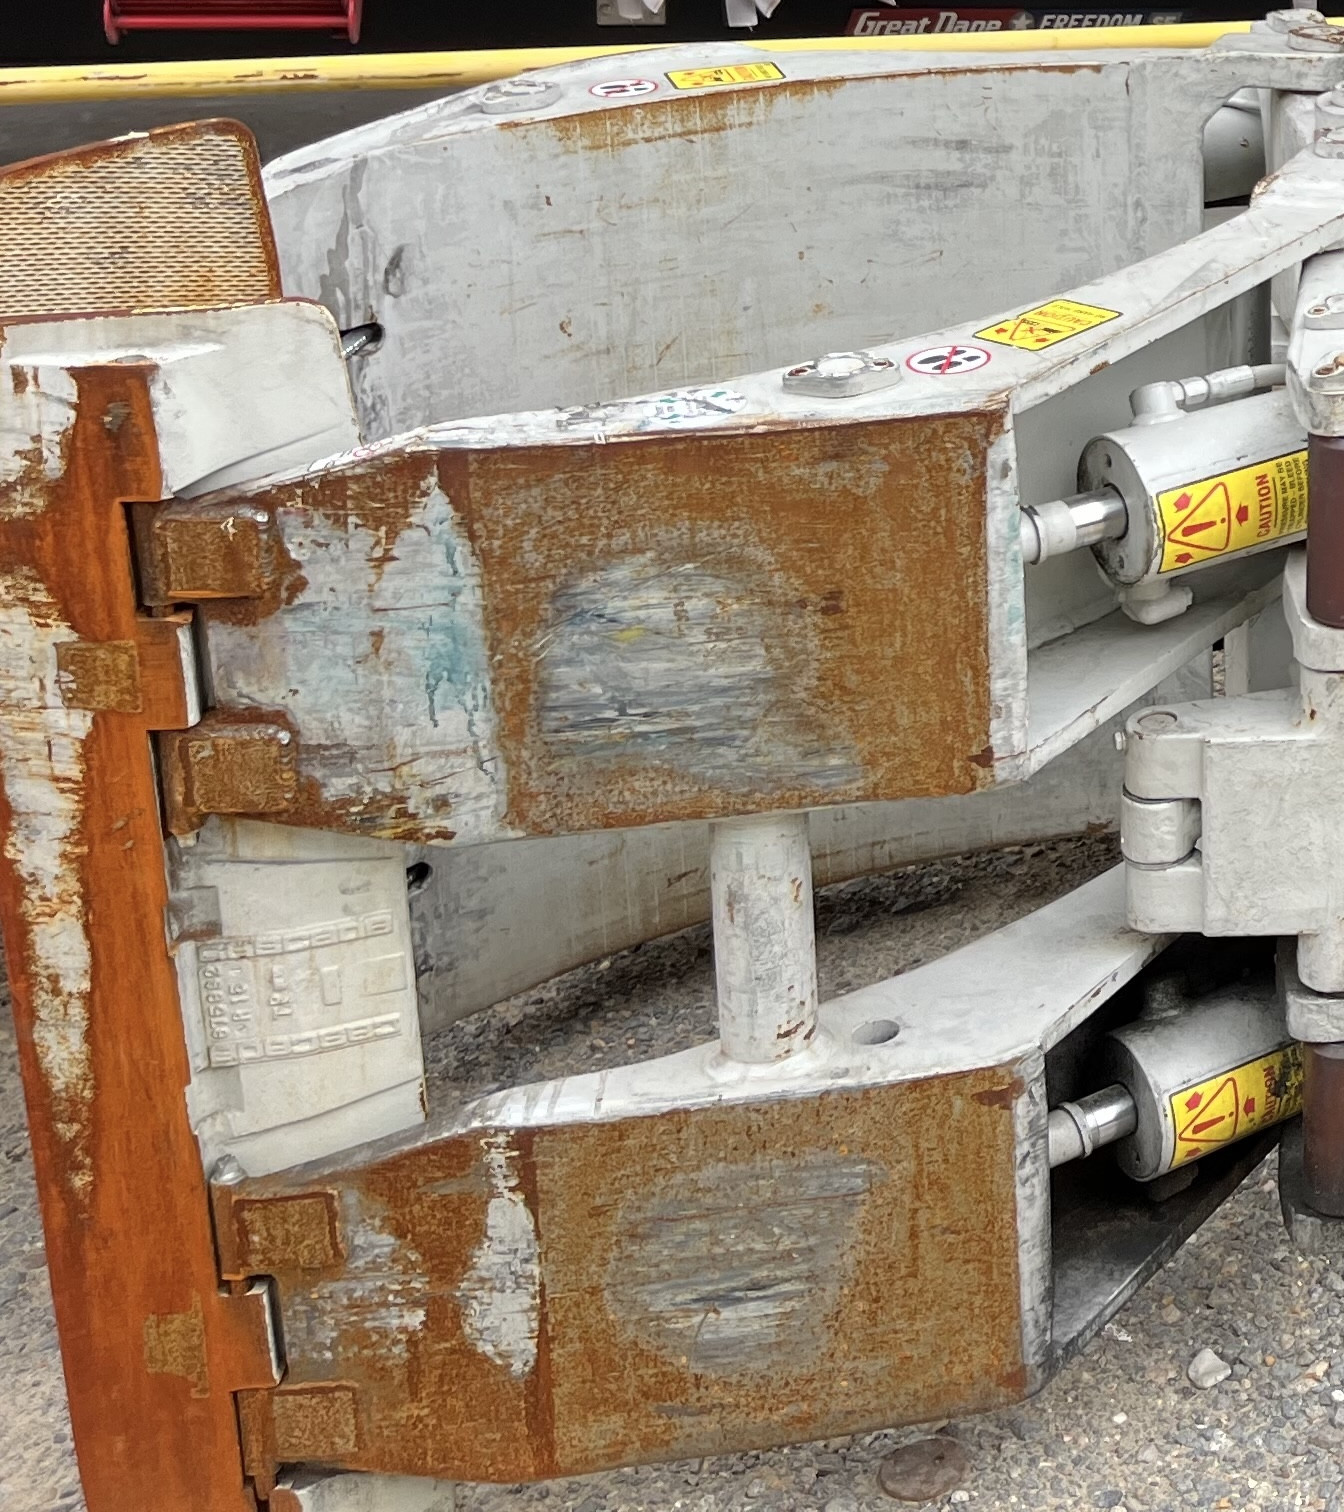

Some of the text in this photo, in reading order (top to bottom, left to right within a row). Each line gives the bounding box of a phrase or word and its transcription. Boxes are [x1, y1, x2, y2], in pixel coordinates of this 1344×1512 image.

[854, 11, 932, 36] Great
[931, 11, 1003, 33] Dane
[1039, 13, 1144, 30] FREEDOM
[1276, 461, 1284, 474] BE
[1284, 460, 1296, 490] BLEED
[1292, 457, 1305, 492] BEFORE
[1279, 476, 1288, 495] MAY
[1255, 473, 1273, 538] CAUTION
